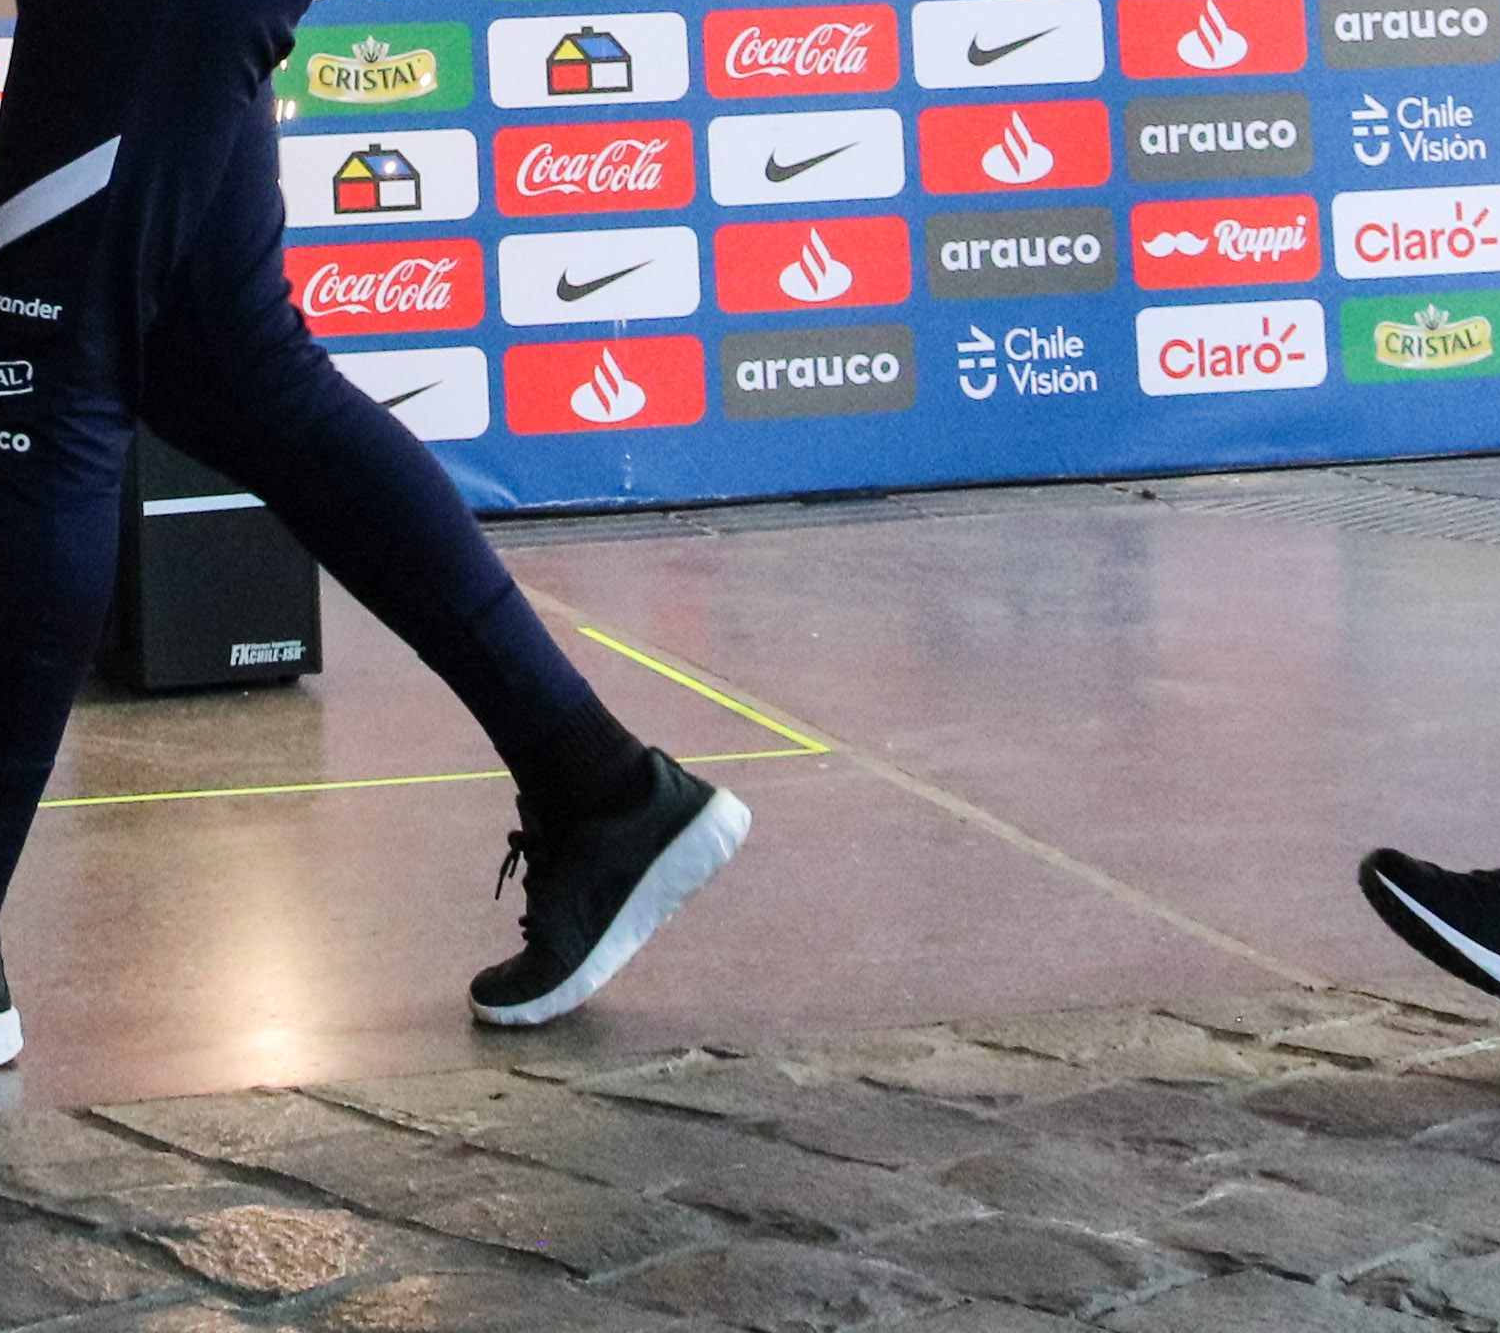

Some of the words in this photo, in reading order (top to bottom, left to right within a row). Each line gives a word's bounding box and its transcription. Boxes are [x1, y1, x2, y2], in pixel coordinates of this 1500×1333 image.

[1334, 6, 1489, 42] arauco
[723, 21, 876, 79] Coca-Cola
[318, 61, 424, 92] CRISTAL
[1396, 94, 1473, 129] Chile
[1138, 117, 1297, 155] arauco
[514, 137, 671, 197] Coca-Cola
[939, 232, 1101, 272] arauco
[1213, 215, 1309, 263] Rappi
[1353, 218, 1476, 263] Claro
[300, 256, 460, 318] Coca-Cola
[1004, 324, 1084, 361] Chile
[1158, 333, 1283, 380] Claro
[1384, 328, 1482, 359] CRISTAL
[735, 351, 900, 392] arauco
